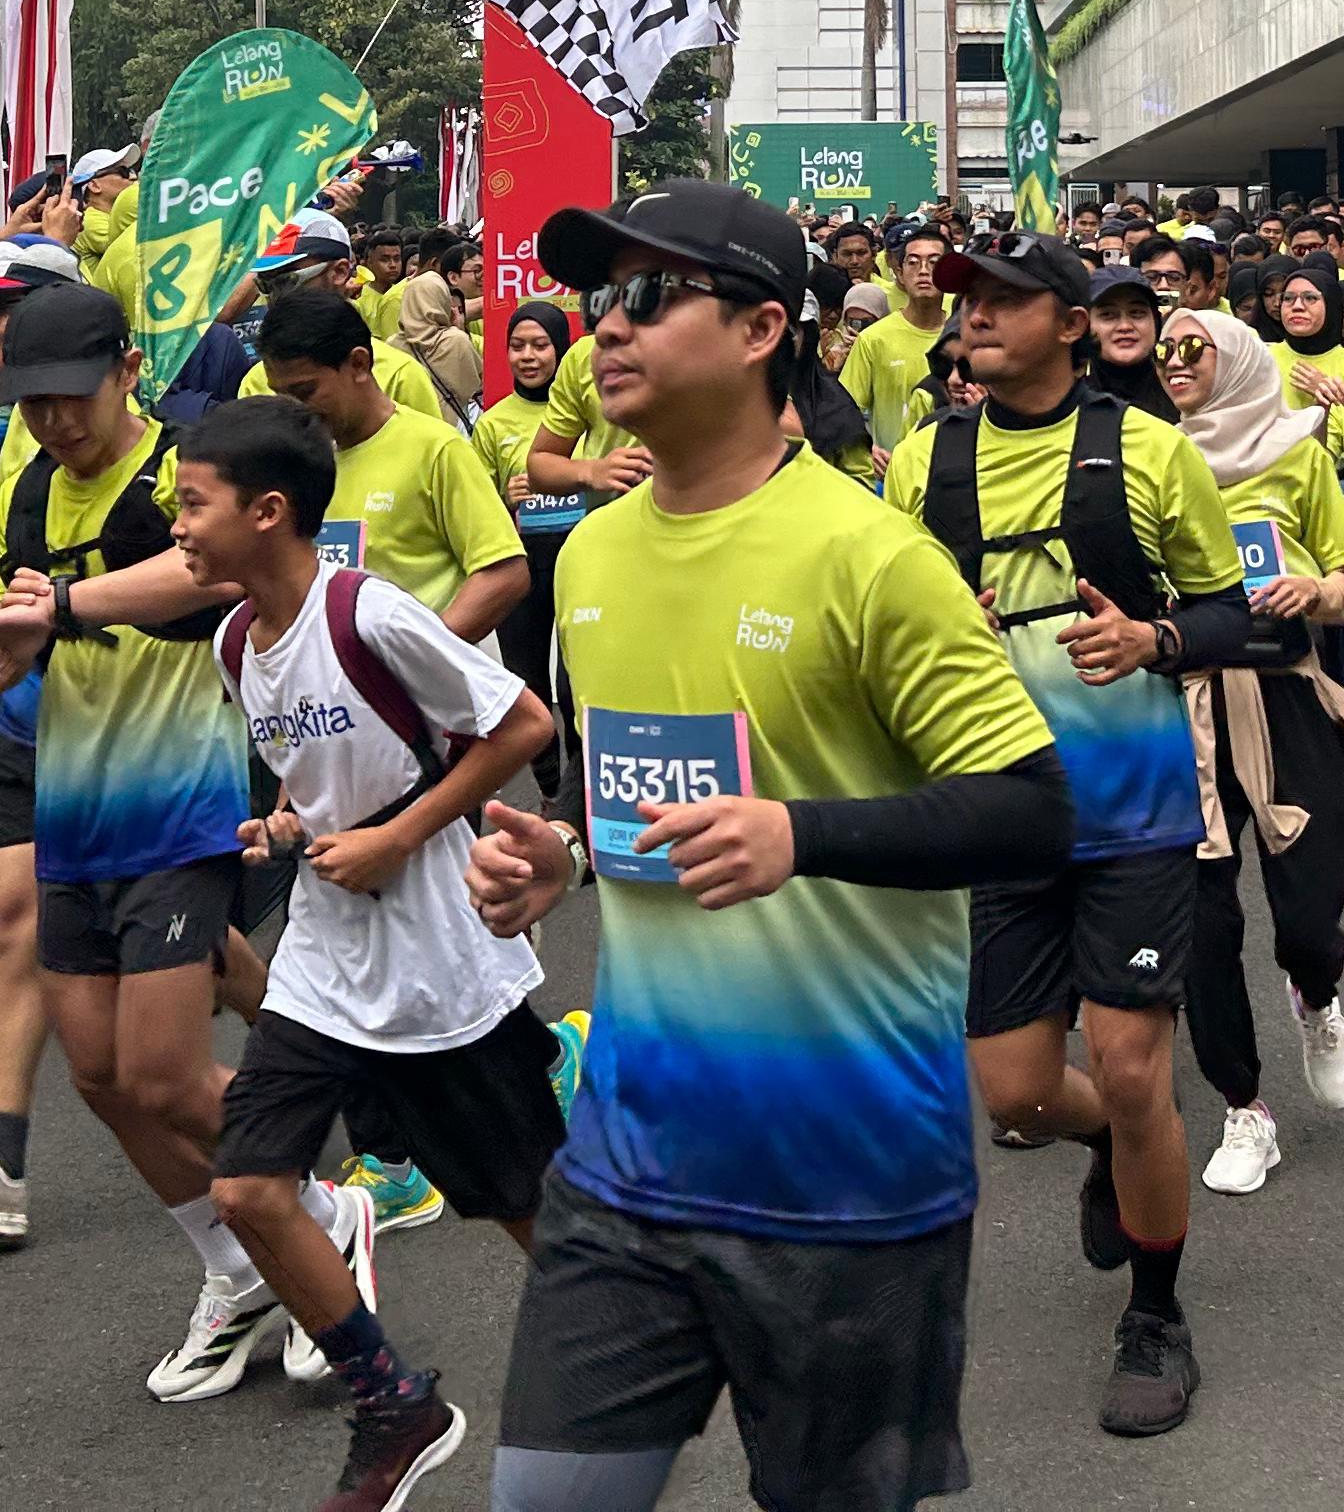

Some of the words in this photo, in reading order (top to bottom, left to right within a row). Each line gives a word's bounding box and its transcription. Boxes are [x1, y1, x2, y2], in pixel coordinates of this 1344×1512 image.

[221, 41, 282, 68] Lelang
[225, 61, 284, 95] RUN
[800, 146, 863, 169] Lelang
[801, 167, 863, 190] RUN
[158, 167, 264, 224] Pace
[497, 232, 539, 260] Lel
[146, 242, 192, 322] 8
[497, 264, 571, 300] RU
[739, 604, 794, 634] Lelang
[736, 623, 789, 653] RUN
[599, 752, 720, 804] 53315
